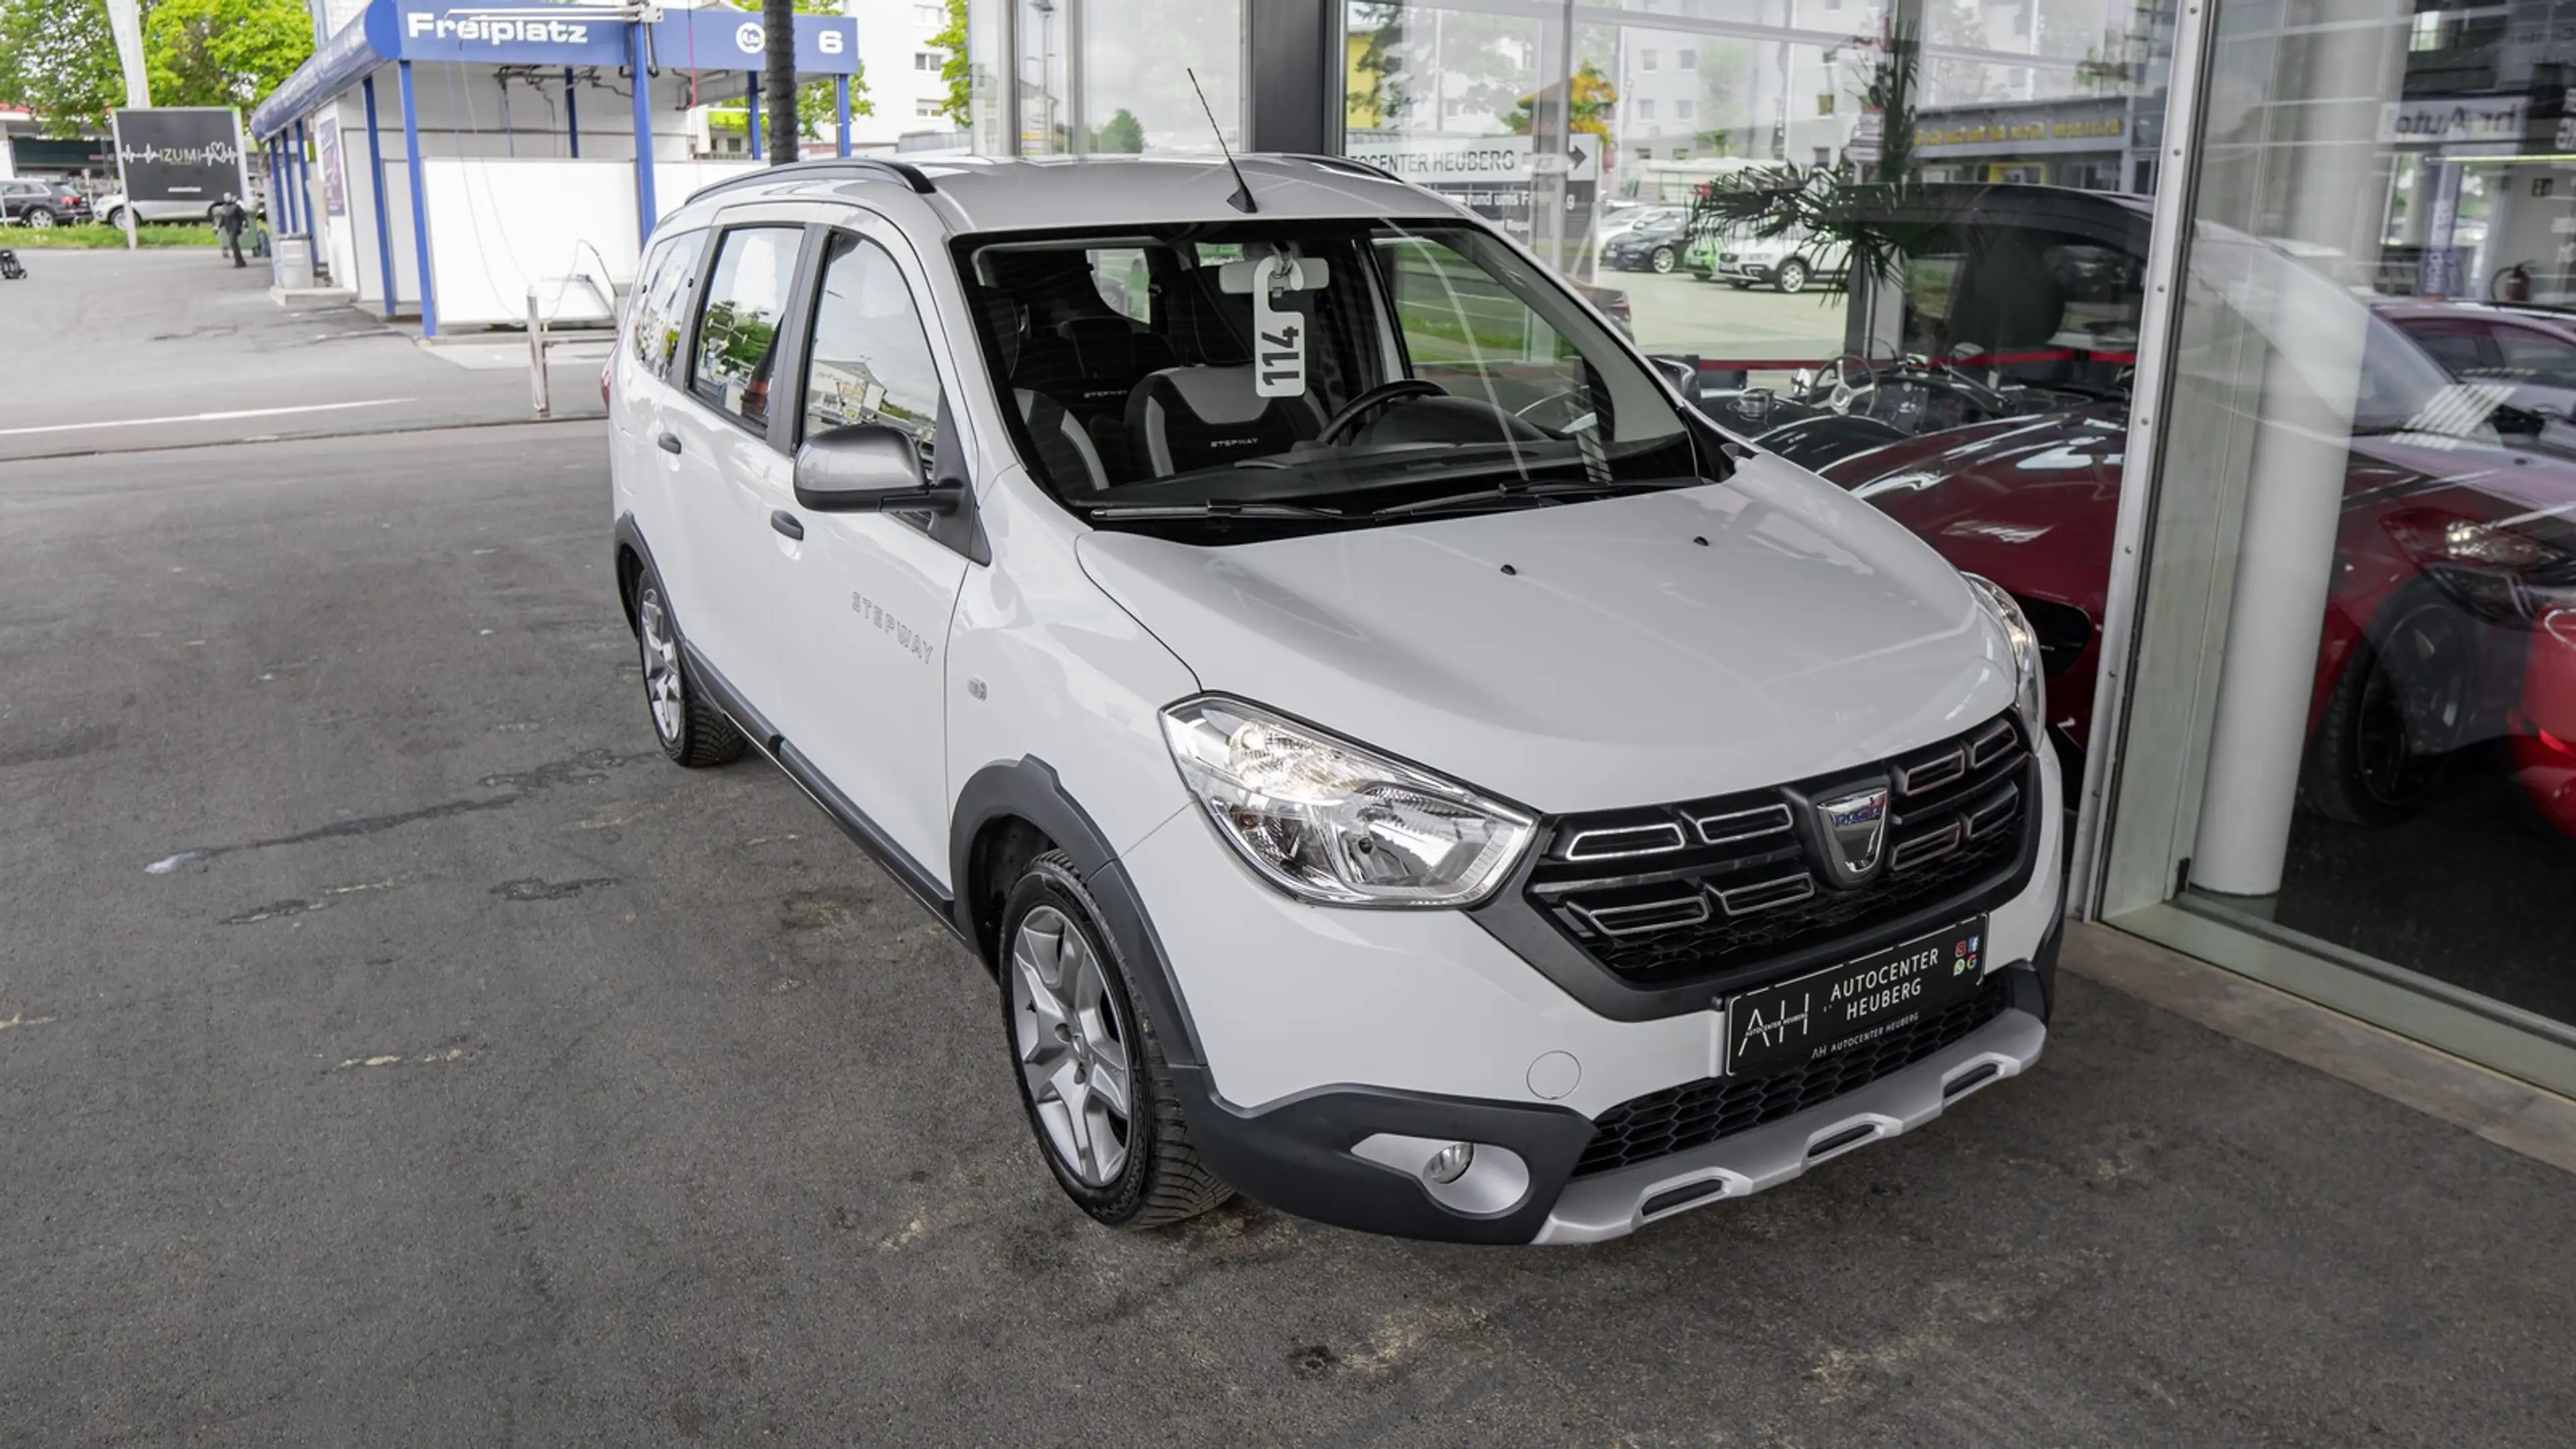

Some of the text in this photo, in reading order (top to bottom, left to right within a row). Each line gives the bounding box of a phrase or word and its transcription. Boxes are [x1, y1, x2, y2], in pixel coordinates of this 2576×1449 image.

[407, 12, 588, 46] Freiplatz
[818, 30, 843, 54] 6
[159, 148, 202, 162] IZUMI
[1433, 149, 1515, 172] HEUBERG
[1261, 325, 1299, 386] 114
[1210, 437, 1259, 448] STEPWAY
[851, 590, 934, 665] STEPWAY
[1830, 947, 1939, 1002] AUTOCENTER
[1846, 977, 1922, 1020] HEUBERG
[1738, 993, 1810, 1057] AH
[1811, 1011, 1919, 1059] AH AUTOCENTER HEUBERG
